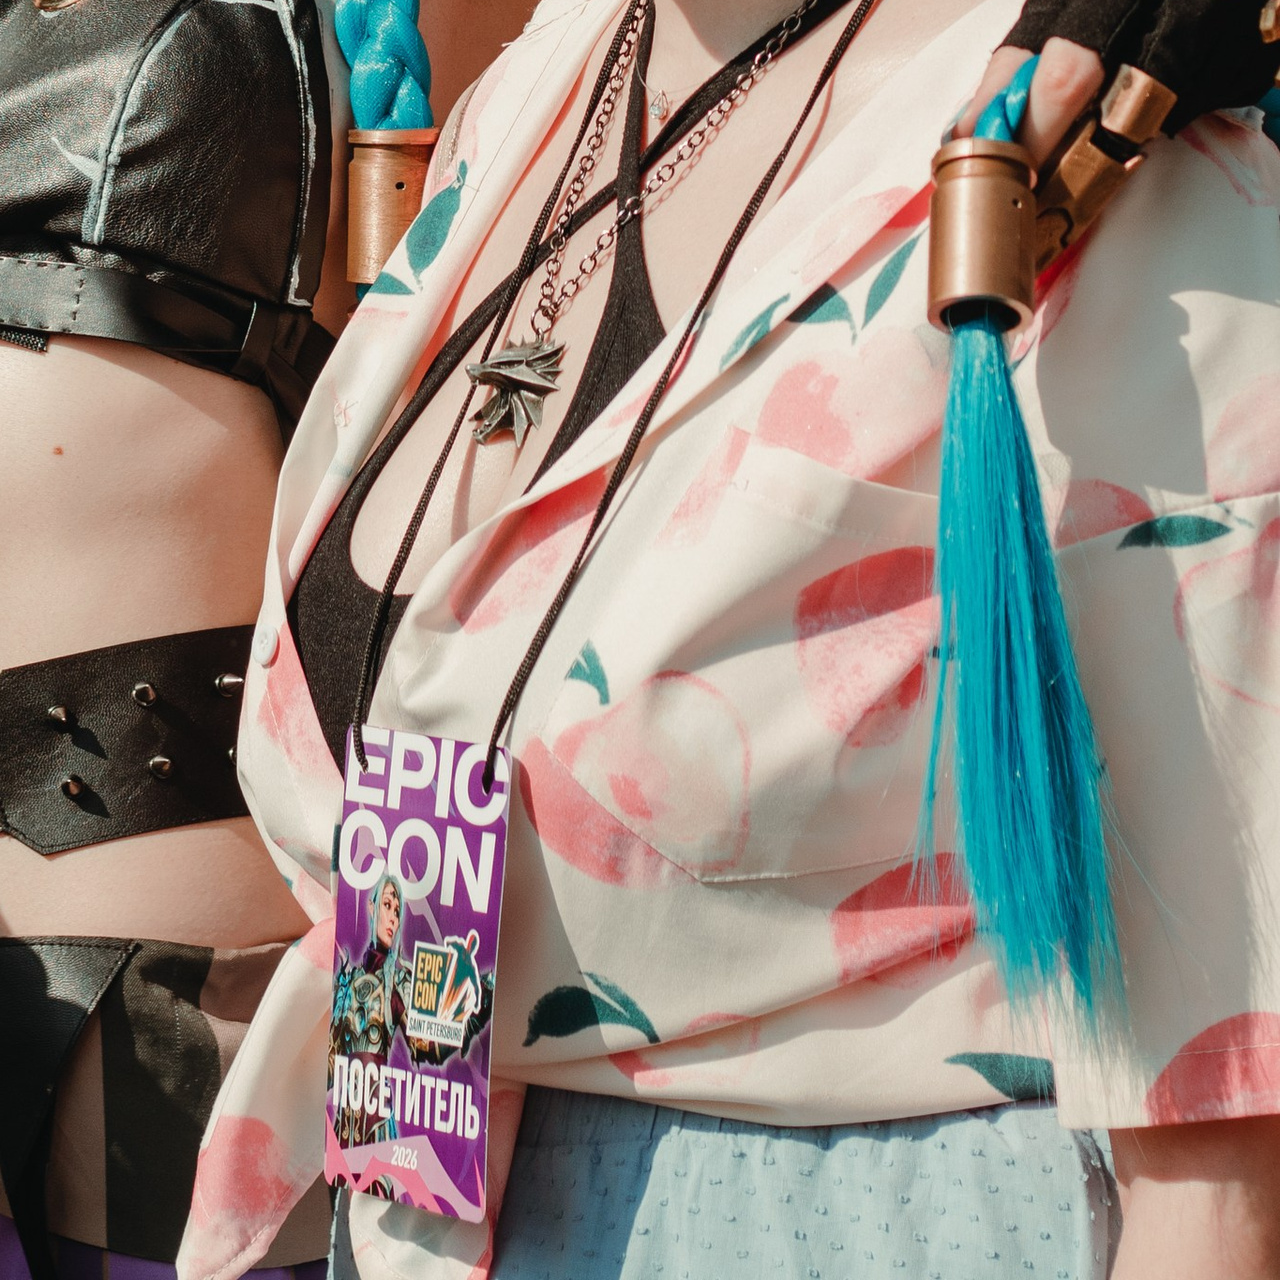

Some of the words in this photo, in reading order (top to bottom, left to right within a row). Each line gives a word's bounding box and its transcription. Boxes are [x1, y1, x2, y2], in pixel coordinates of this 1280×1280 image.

[345, 725, 510, 826] EPIC
[339, 809, 497, 914] CON
[416, 951, 443, 983] EPIC
[414, 980, 437, 1011] CON
[409, 1017, 426, 1034] SAINT
[426, 1021, 463, 1042] PETERSBURG
[332, 1055, 480, 1140] ПОСЕТИТЕЛЬ
[391, 1145, 418, 1171] 2026
